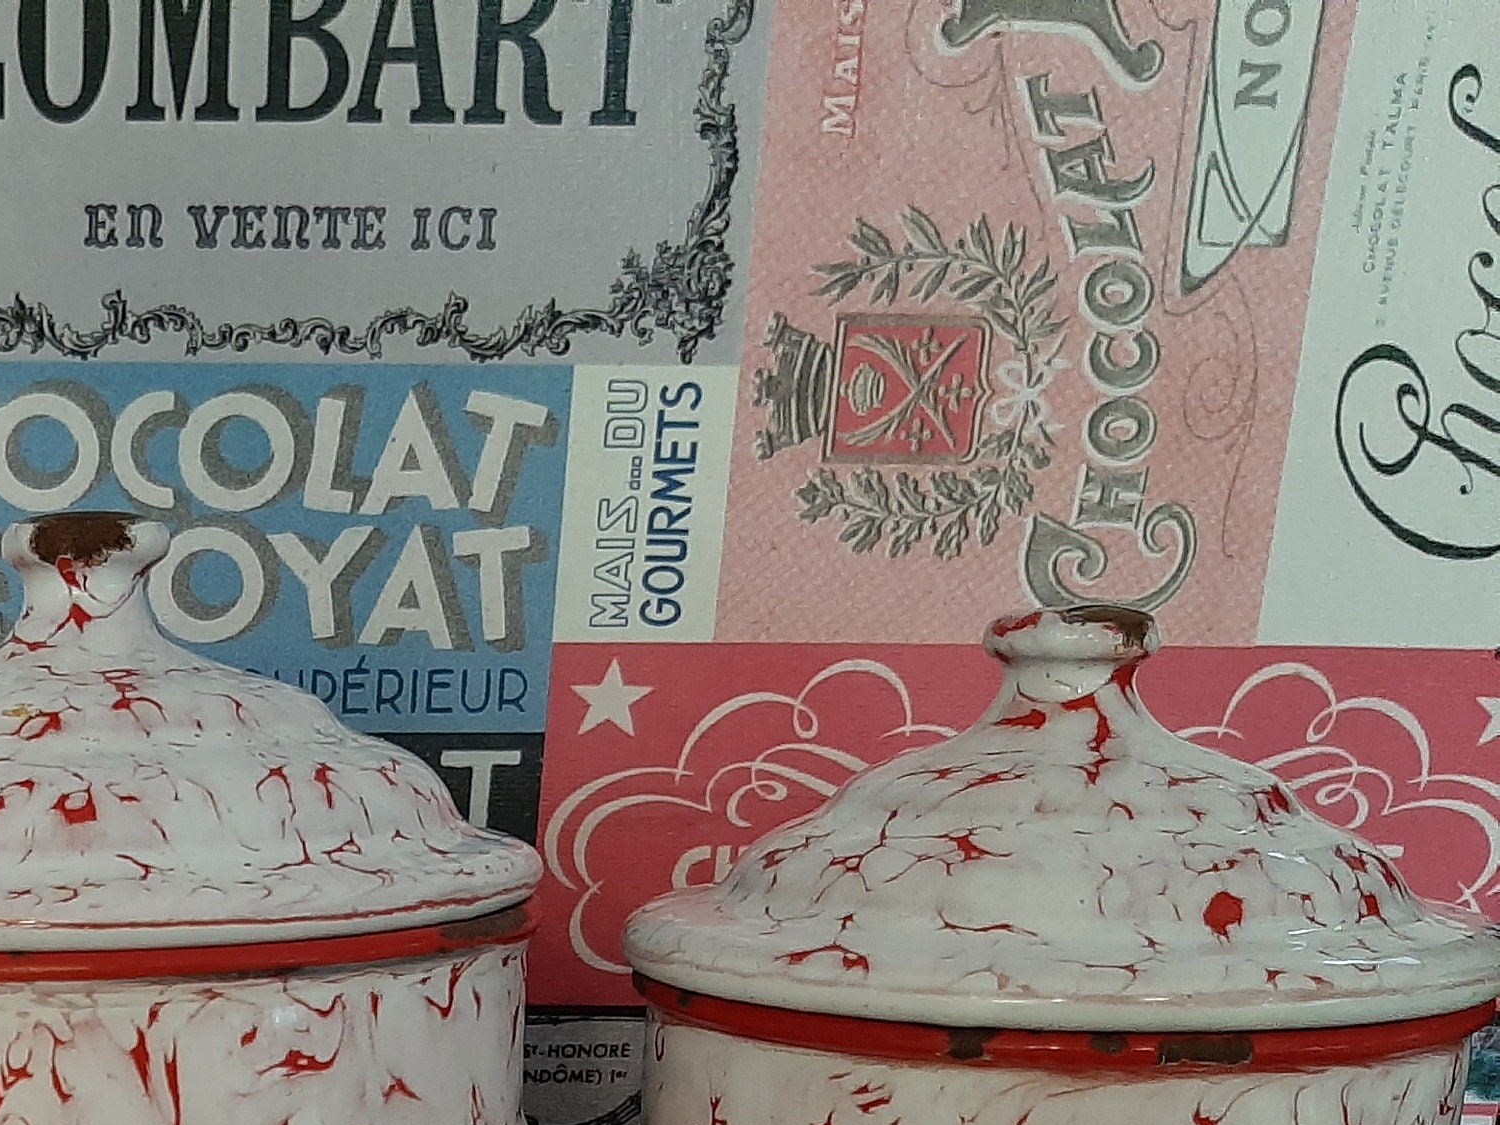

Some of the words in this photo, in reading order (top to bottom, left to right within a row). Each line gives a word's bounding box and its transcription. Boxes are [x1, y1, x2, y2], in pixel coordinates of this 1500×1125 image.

[188, 205, 387, 252] VENTE
[411, 207, 498, 251] ICI
[638, 381, 704, 628] GOURMETS
